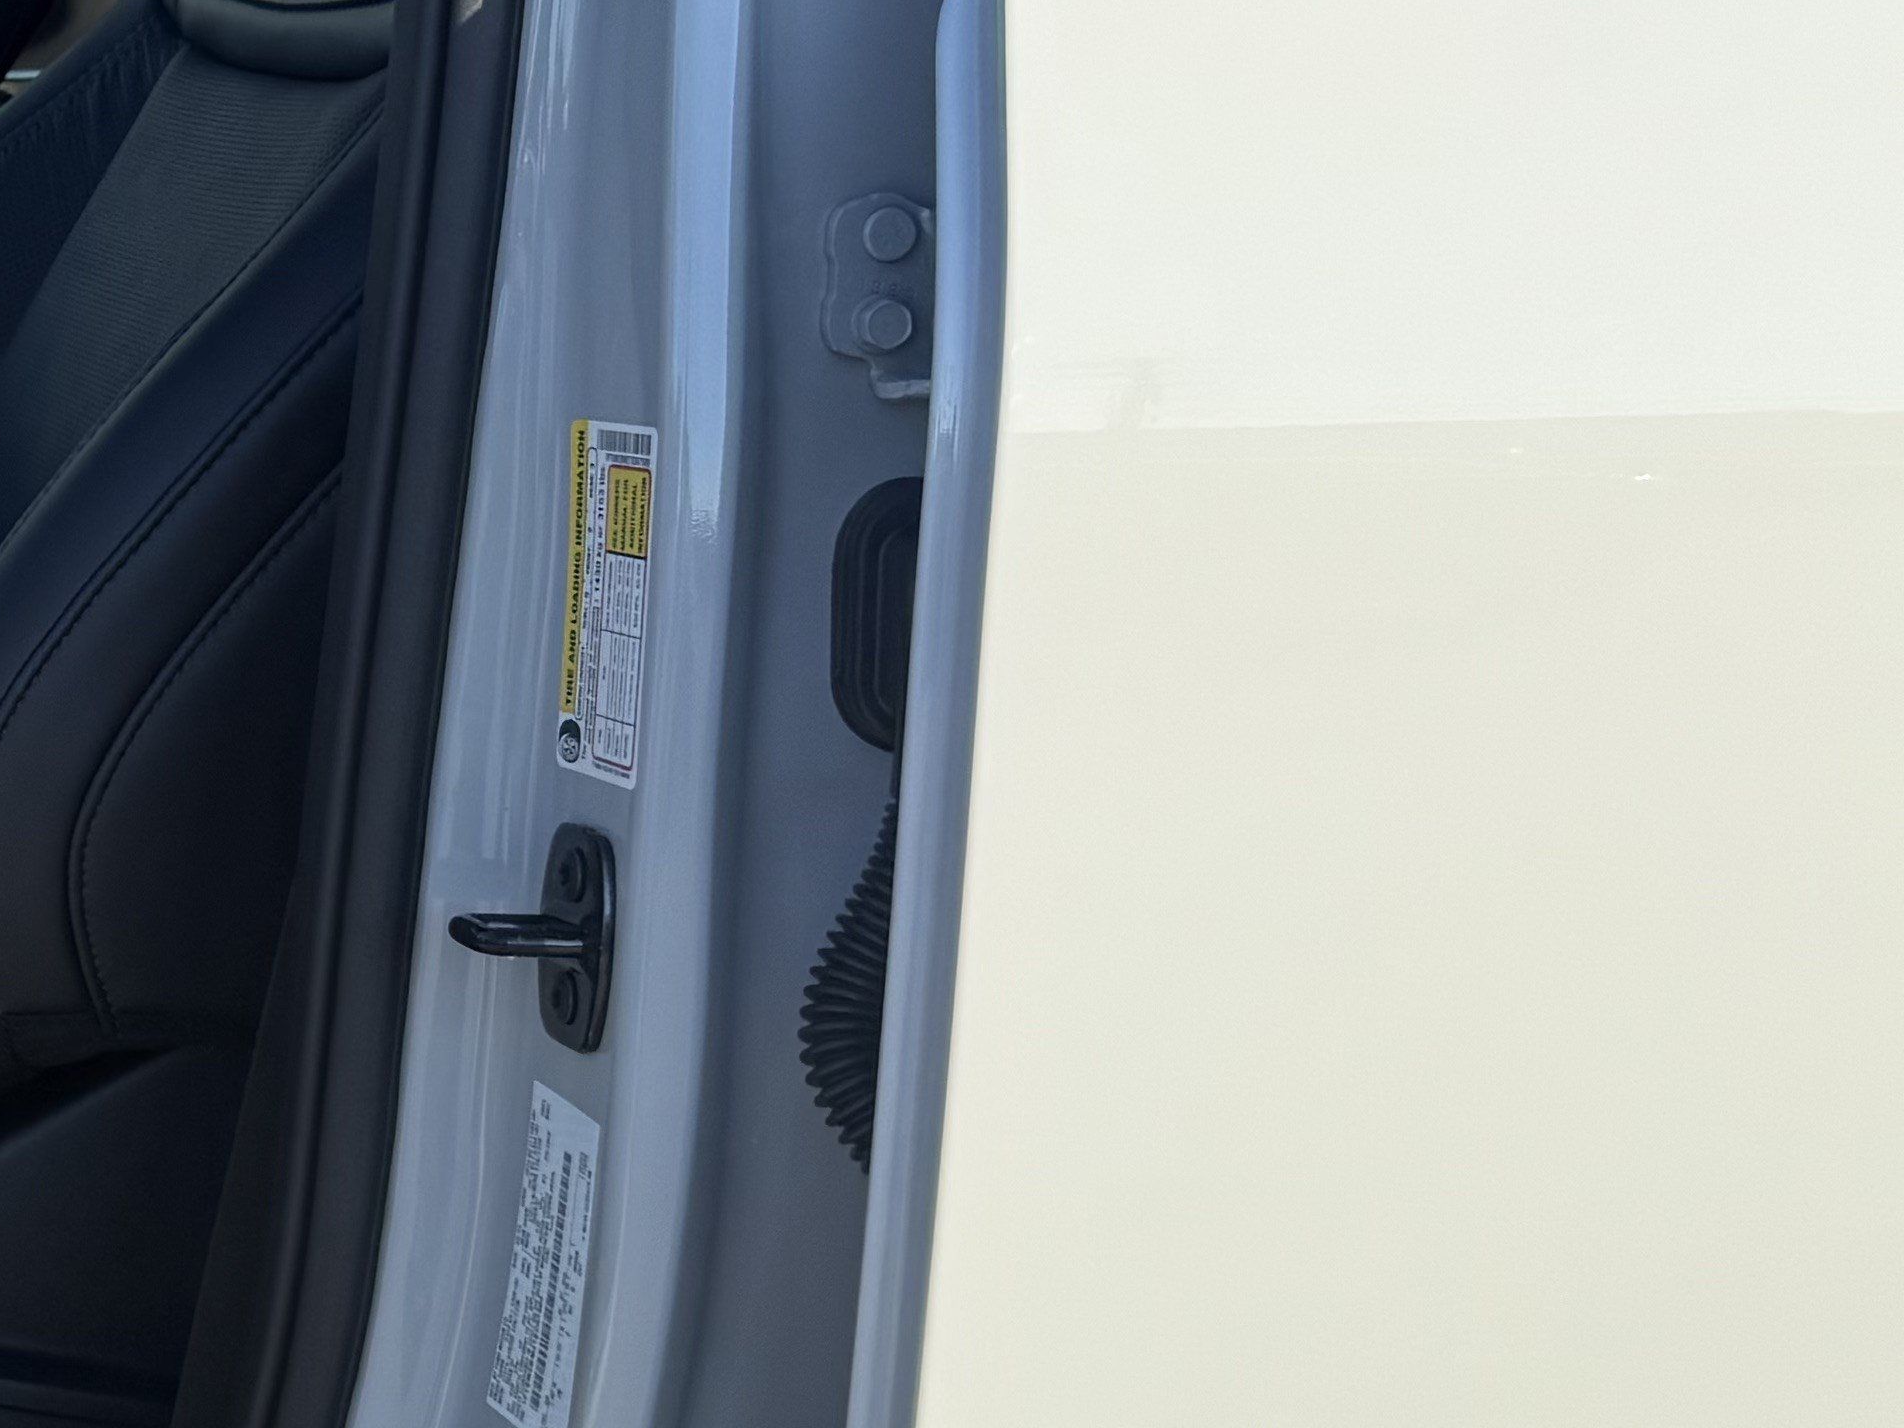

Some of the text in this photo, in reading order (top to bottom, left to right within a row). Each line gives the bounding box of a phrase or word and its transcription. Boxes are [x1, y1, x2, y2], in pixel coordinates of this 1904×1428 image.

[565, 429, 586, 704] TIRE AND LOADING INFORMATION
